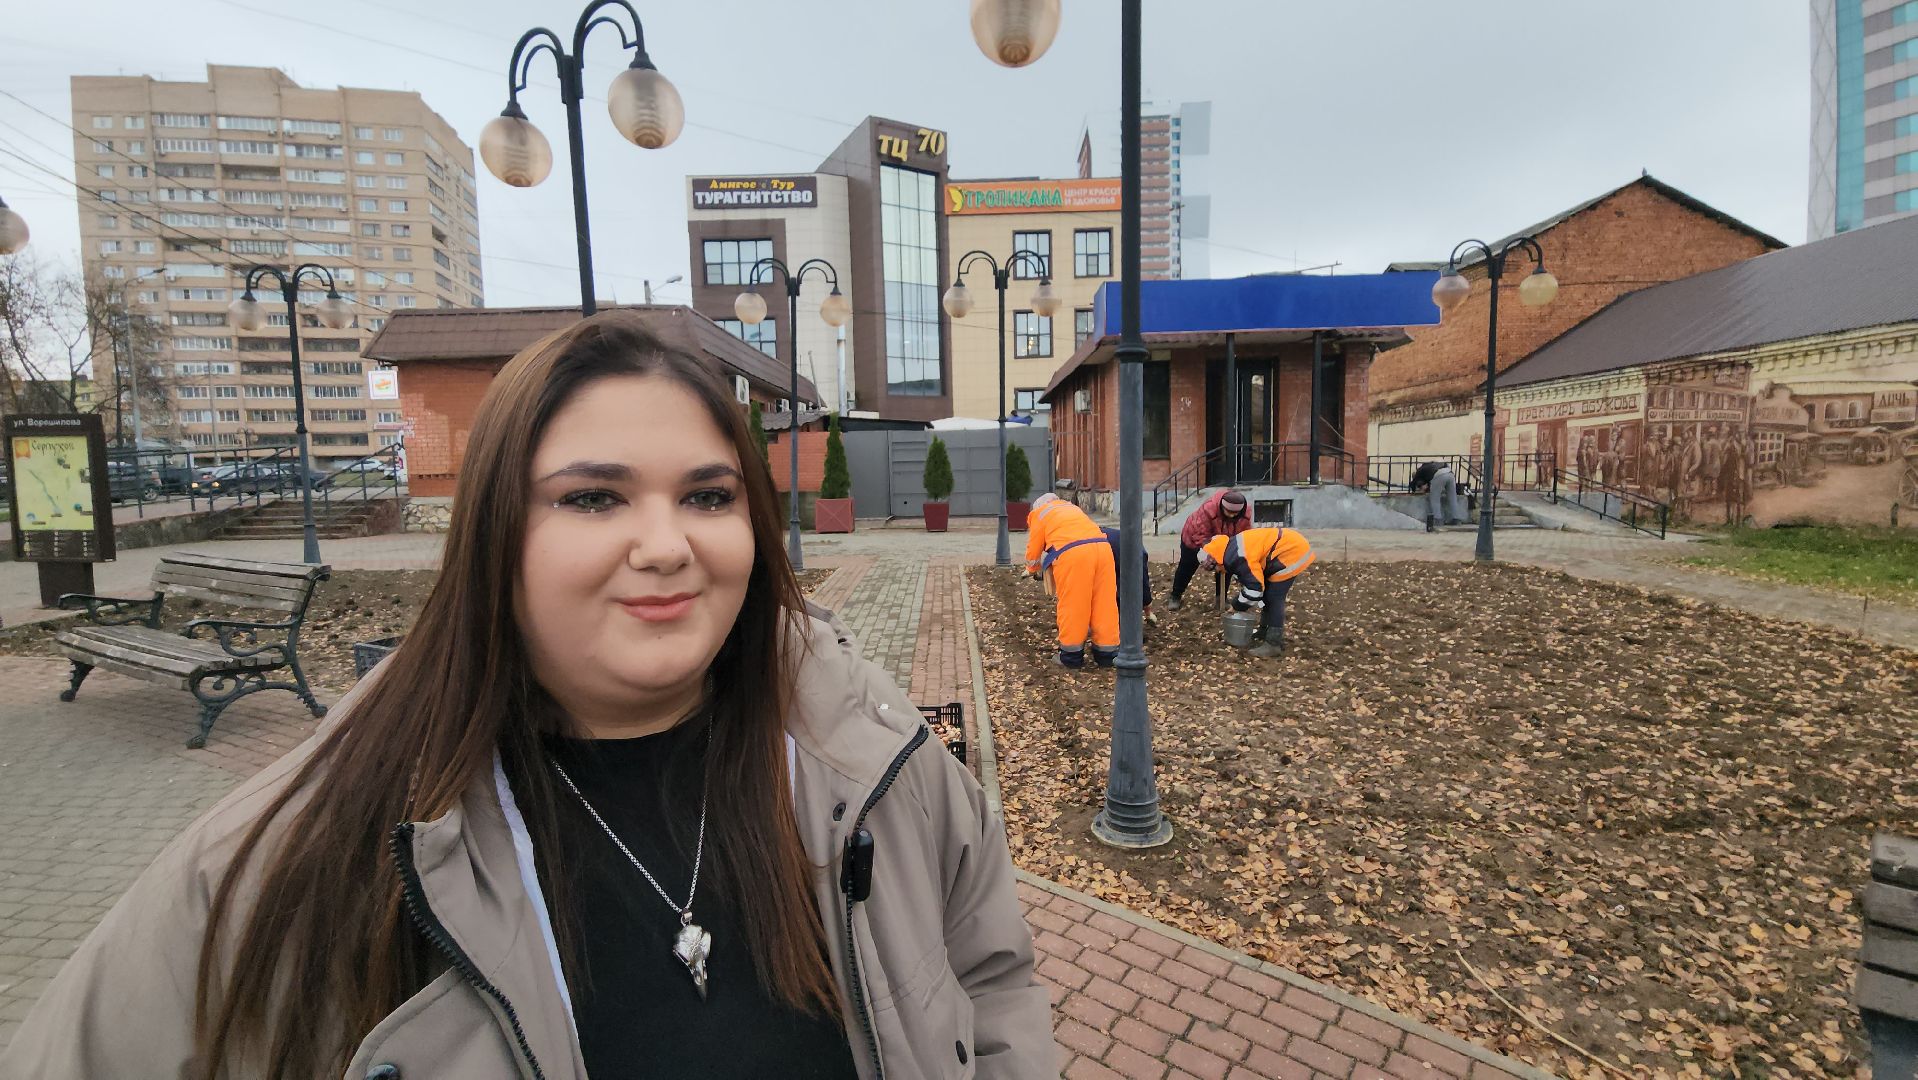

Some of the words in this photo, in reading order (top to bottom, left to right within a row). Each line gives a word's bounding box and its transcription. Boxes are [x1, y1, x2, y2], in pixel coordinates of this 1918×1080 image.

[918, 128, 945, 155] 70
[710, 179, 756, 189] Амигос
[771, 179, 795, 190] Тур
[695, 190, 812, 204] ТУРАГЕНТСТВО
[966, 187, 1062, 208] ТРОПИКАНА
[1064, 187, 1087, 197] ЦЕНТР
[13, 419, 25, 428] ул.
[27, 418, 81, 427] Ворошилова
